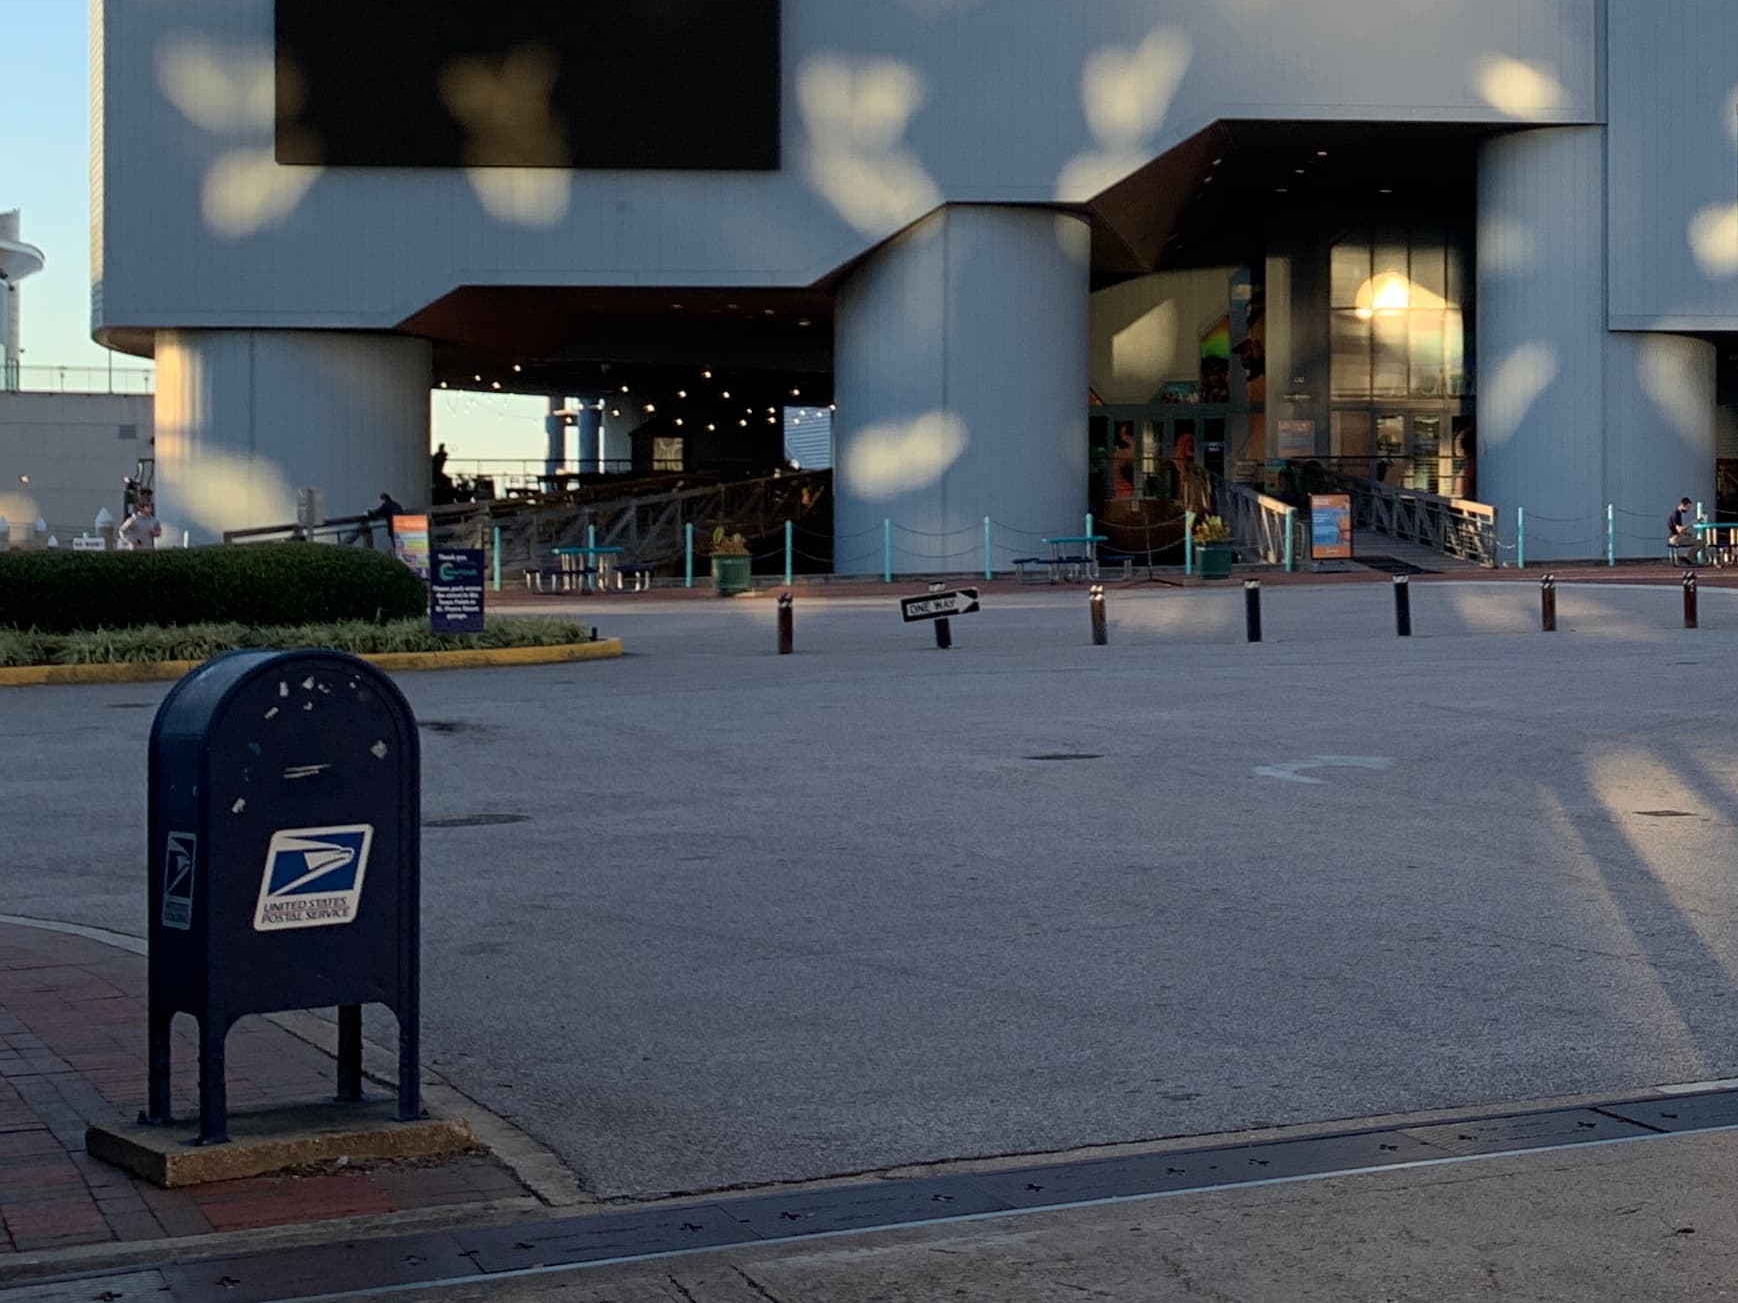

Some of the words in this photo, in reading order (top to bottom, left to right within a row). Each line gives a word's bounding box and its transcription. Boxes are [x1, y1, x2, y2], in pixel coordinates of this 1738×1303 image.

[910, 602, 928, 614] ONE
[935, 598, 955, 610] WAY
[264, 900, 307, 912] UNITED
[308, 897, 347, 908] STATES
[261, 912, 303, 924] POSTAL
[306, 909, 349, 920] SERVICE
